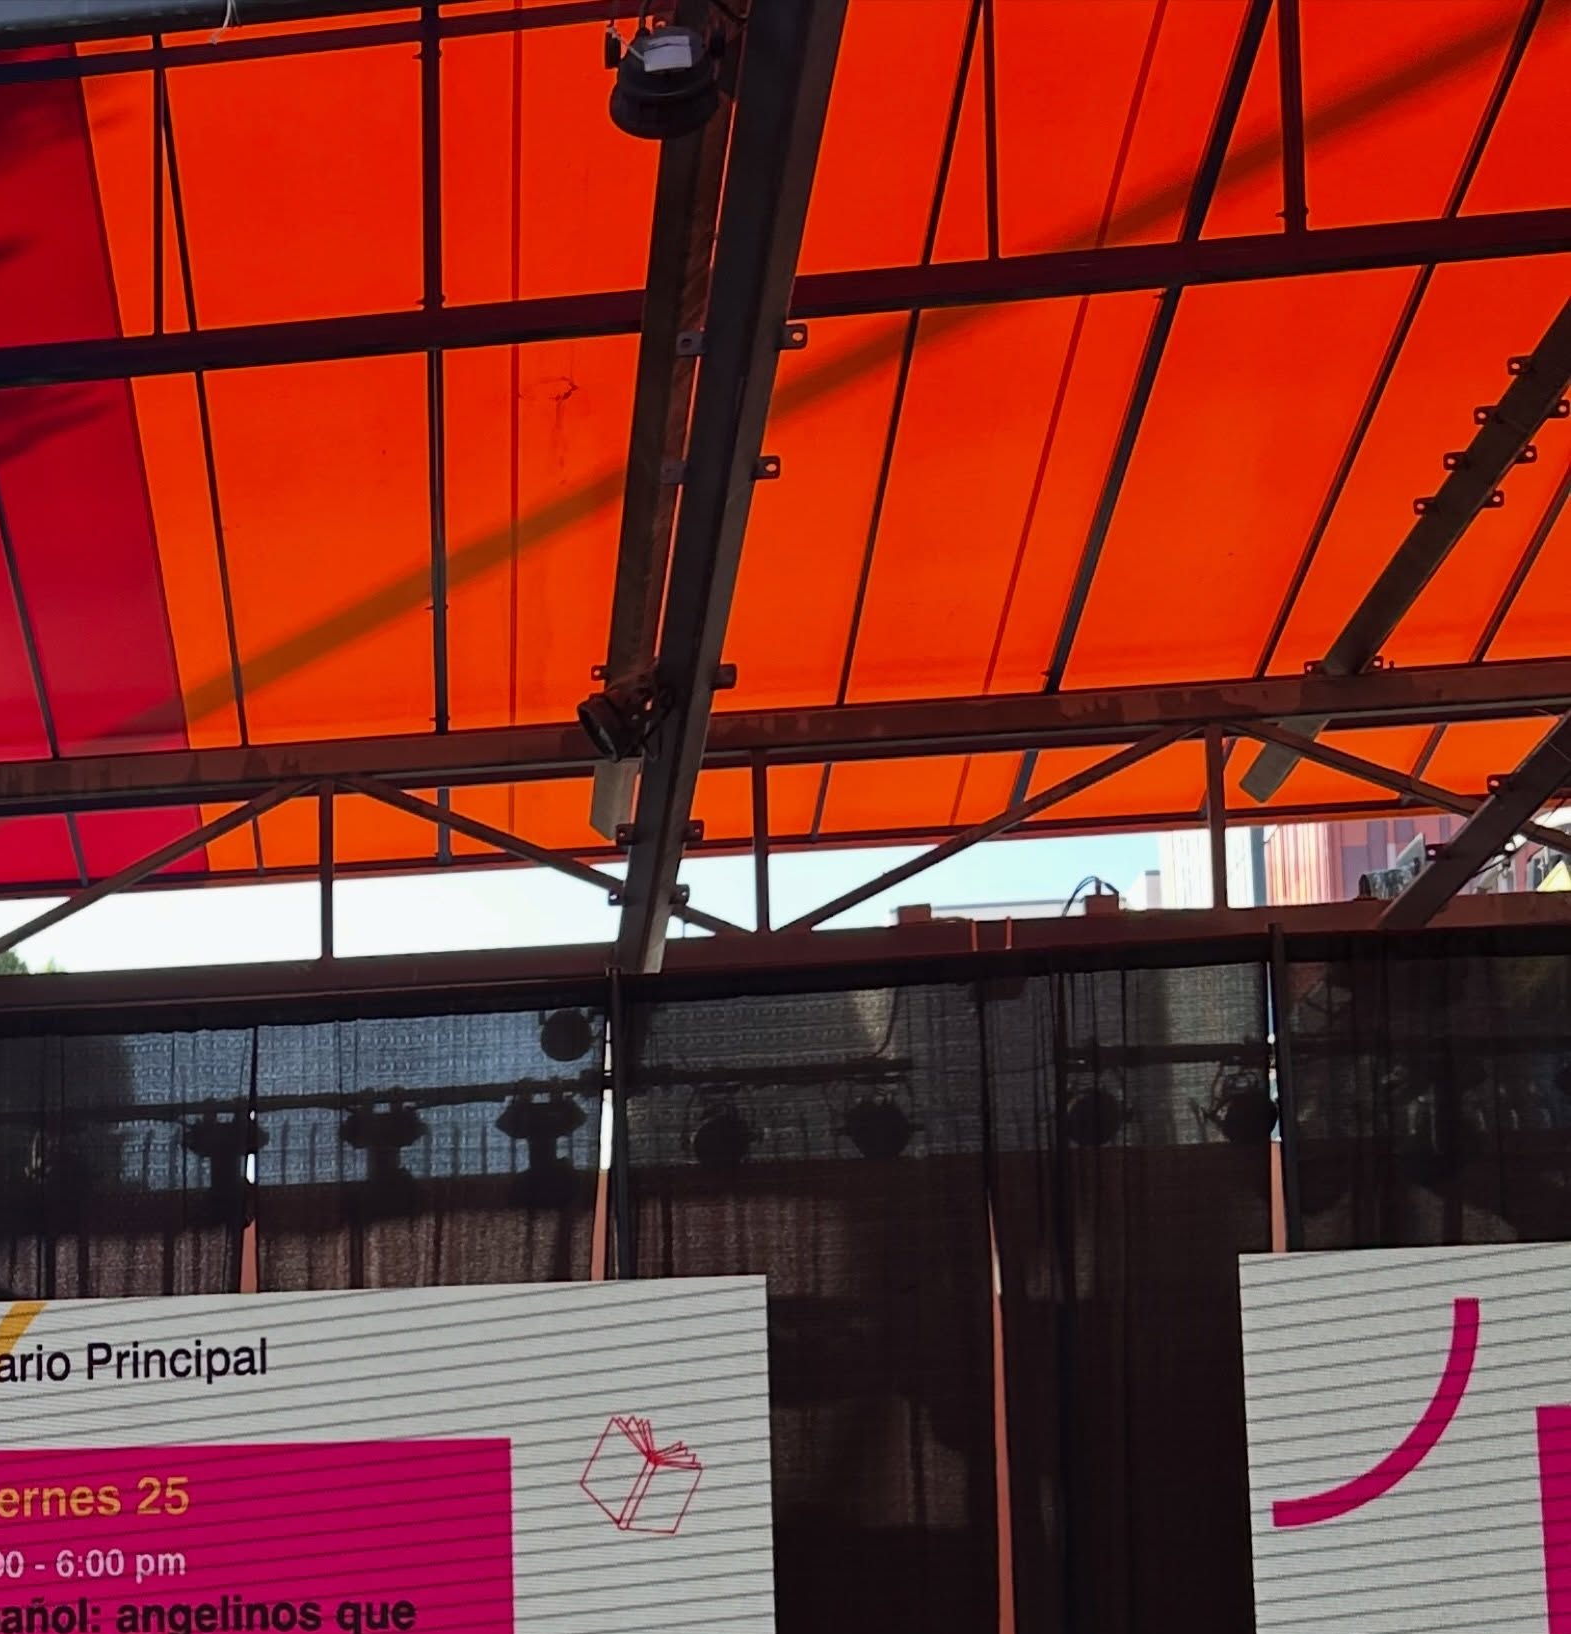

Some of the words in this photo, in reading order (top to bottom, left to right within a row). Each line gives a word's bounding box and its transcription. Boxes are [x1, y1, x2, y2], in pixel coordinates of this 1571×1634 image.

[86, 1338, 268, 1385] Principal
[136, 1476, 190, 1516] 25
[55, 1549, 125, 1578] 6:00
[135, 1552, 187, 1584] pm
